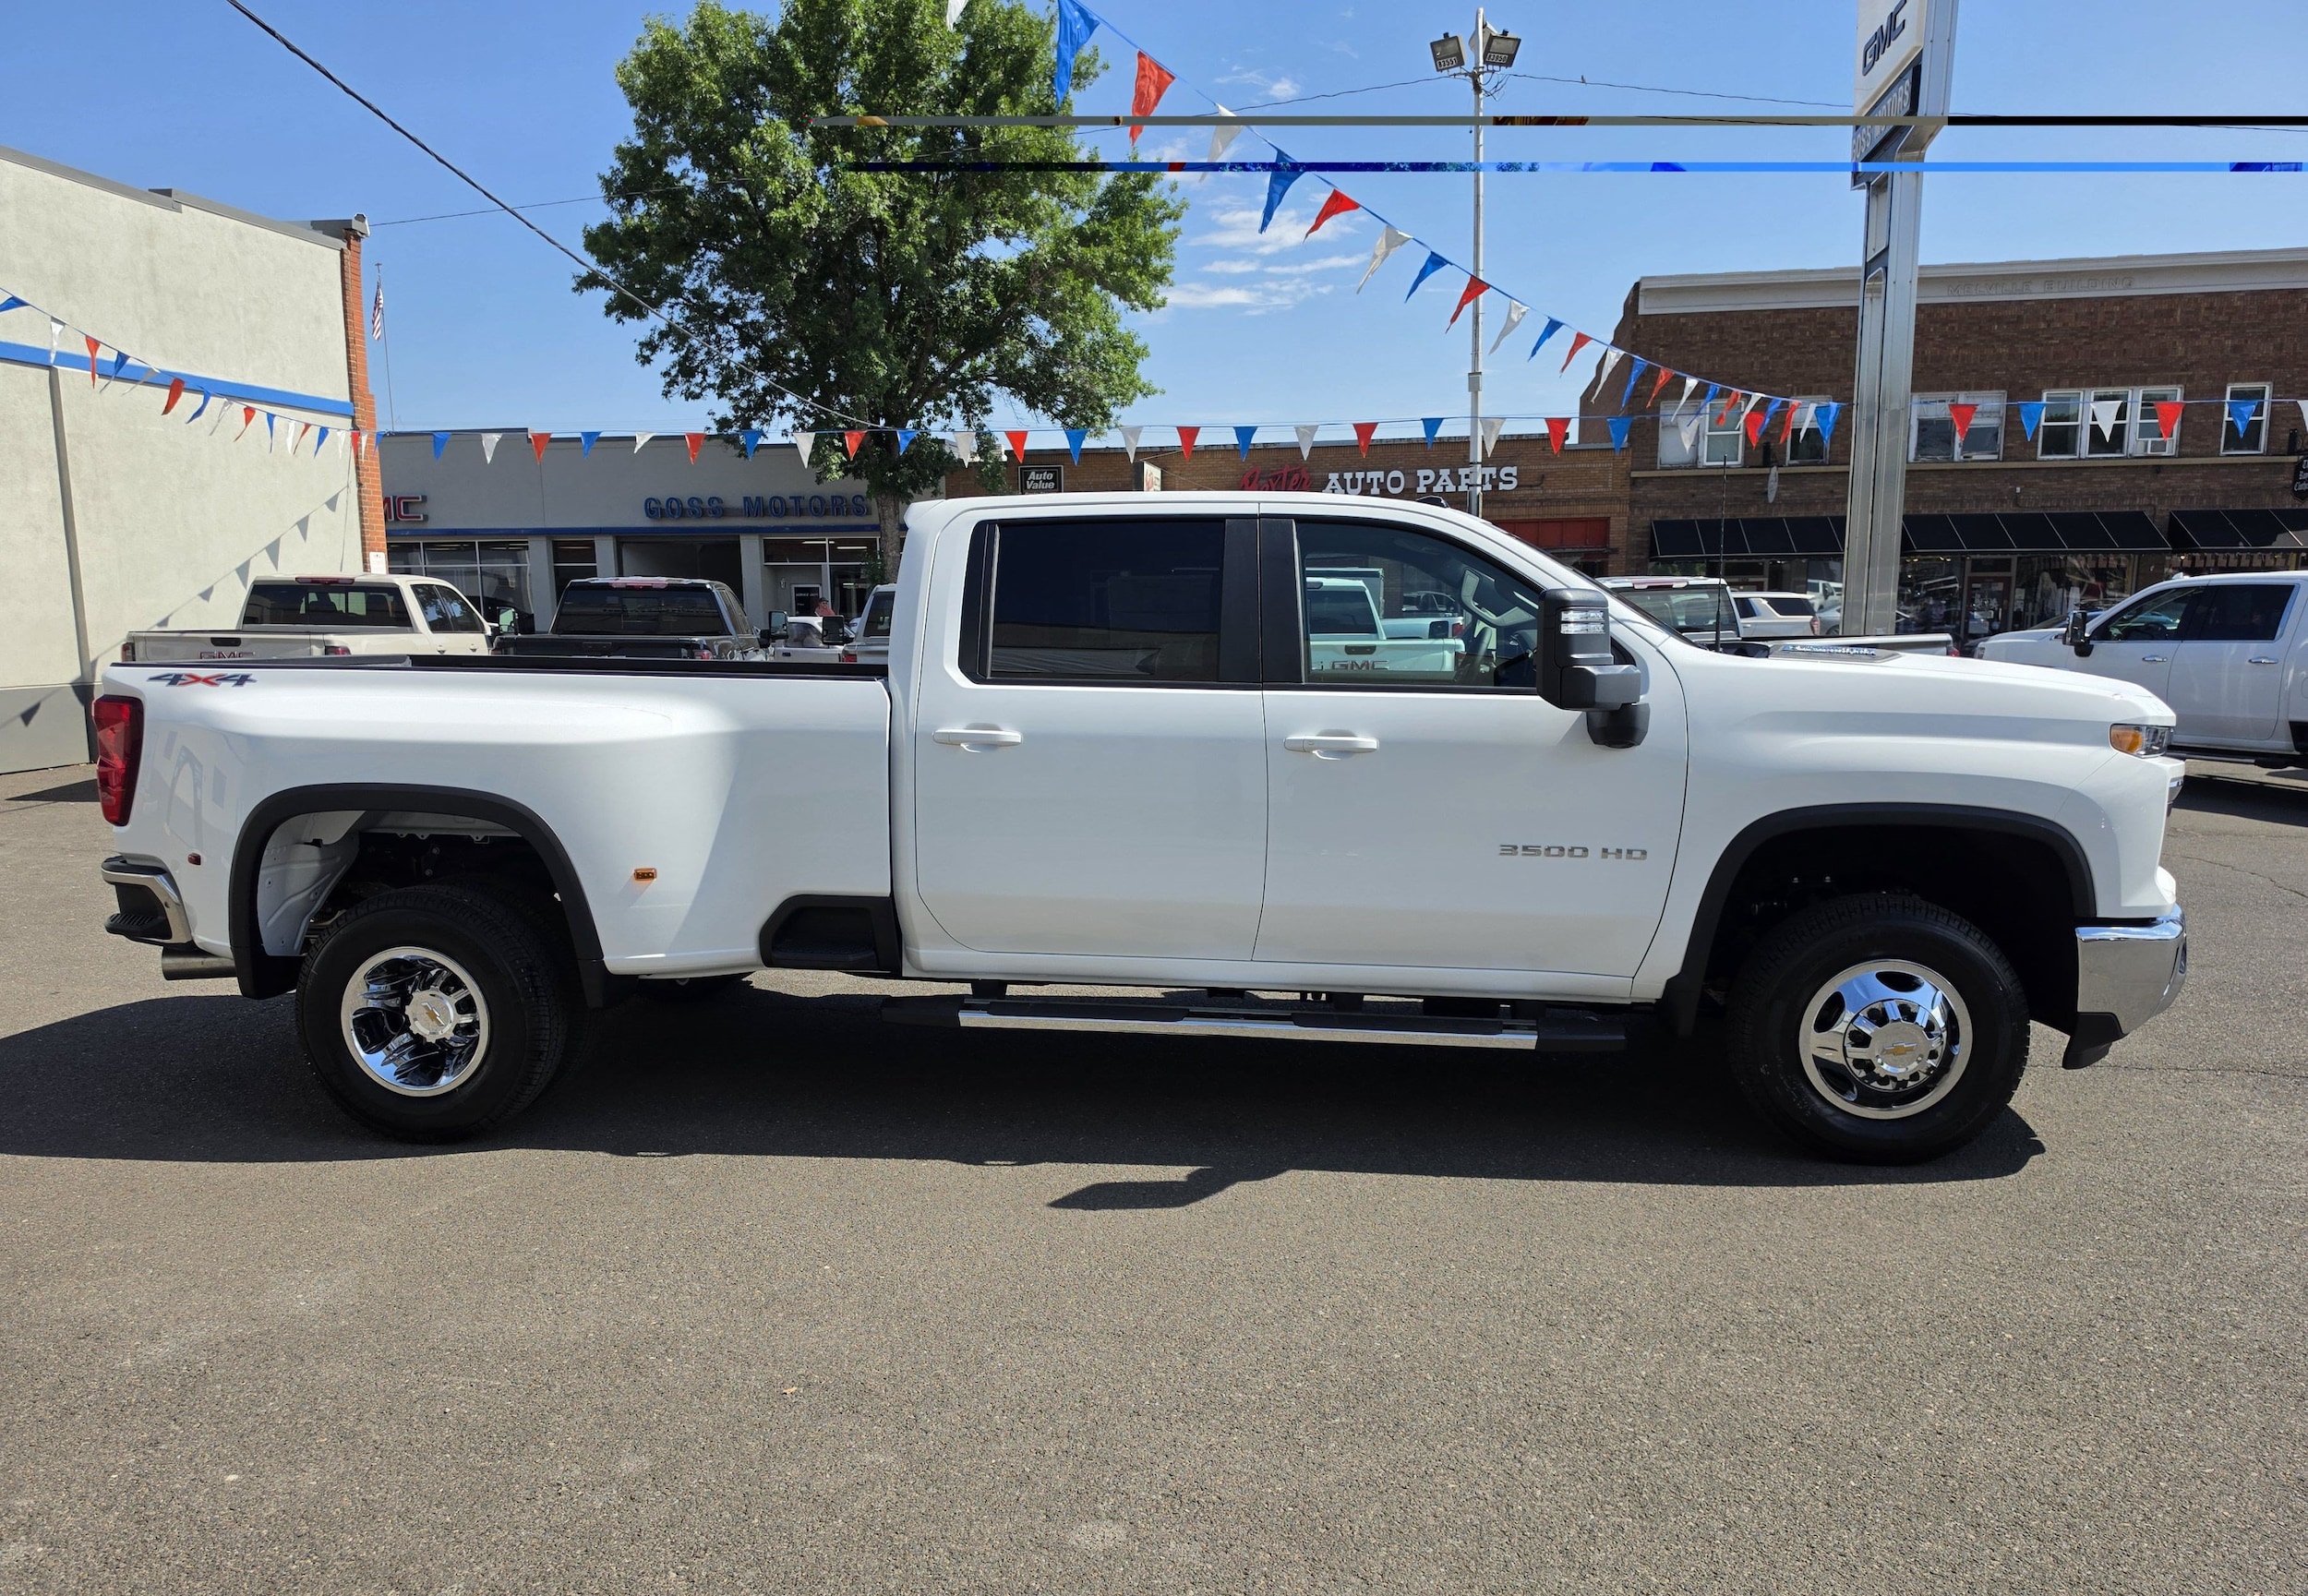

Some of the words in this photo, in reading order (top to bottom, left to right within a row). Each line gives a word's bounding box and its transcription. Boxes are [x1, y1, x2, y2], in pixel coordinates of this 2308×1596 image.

[1862, 0, 1906, 77] GMC
[1947, 281, 2034, 296] MELVILLE
[2043, 278, 2136, 293] BUILDING
[1027, 471, 1054, 480] Auto
[1322, 470, 1405, 496] AUTO
[1416, 466, 1519, 493] PARTS
[1026, 480, 1055, 489] Value
[643, 497, 725, 520] GOSS
[742, 494, 868, 518] MOTORS
[199, 651, 256, 660] GMC
[1331, 660, 1389, 670] GMC
[1498, 844, 1590, 858] 3500
[1601, 846, 1648, 861] HD
